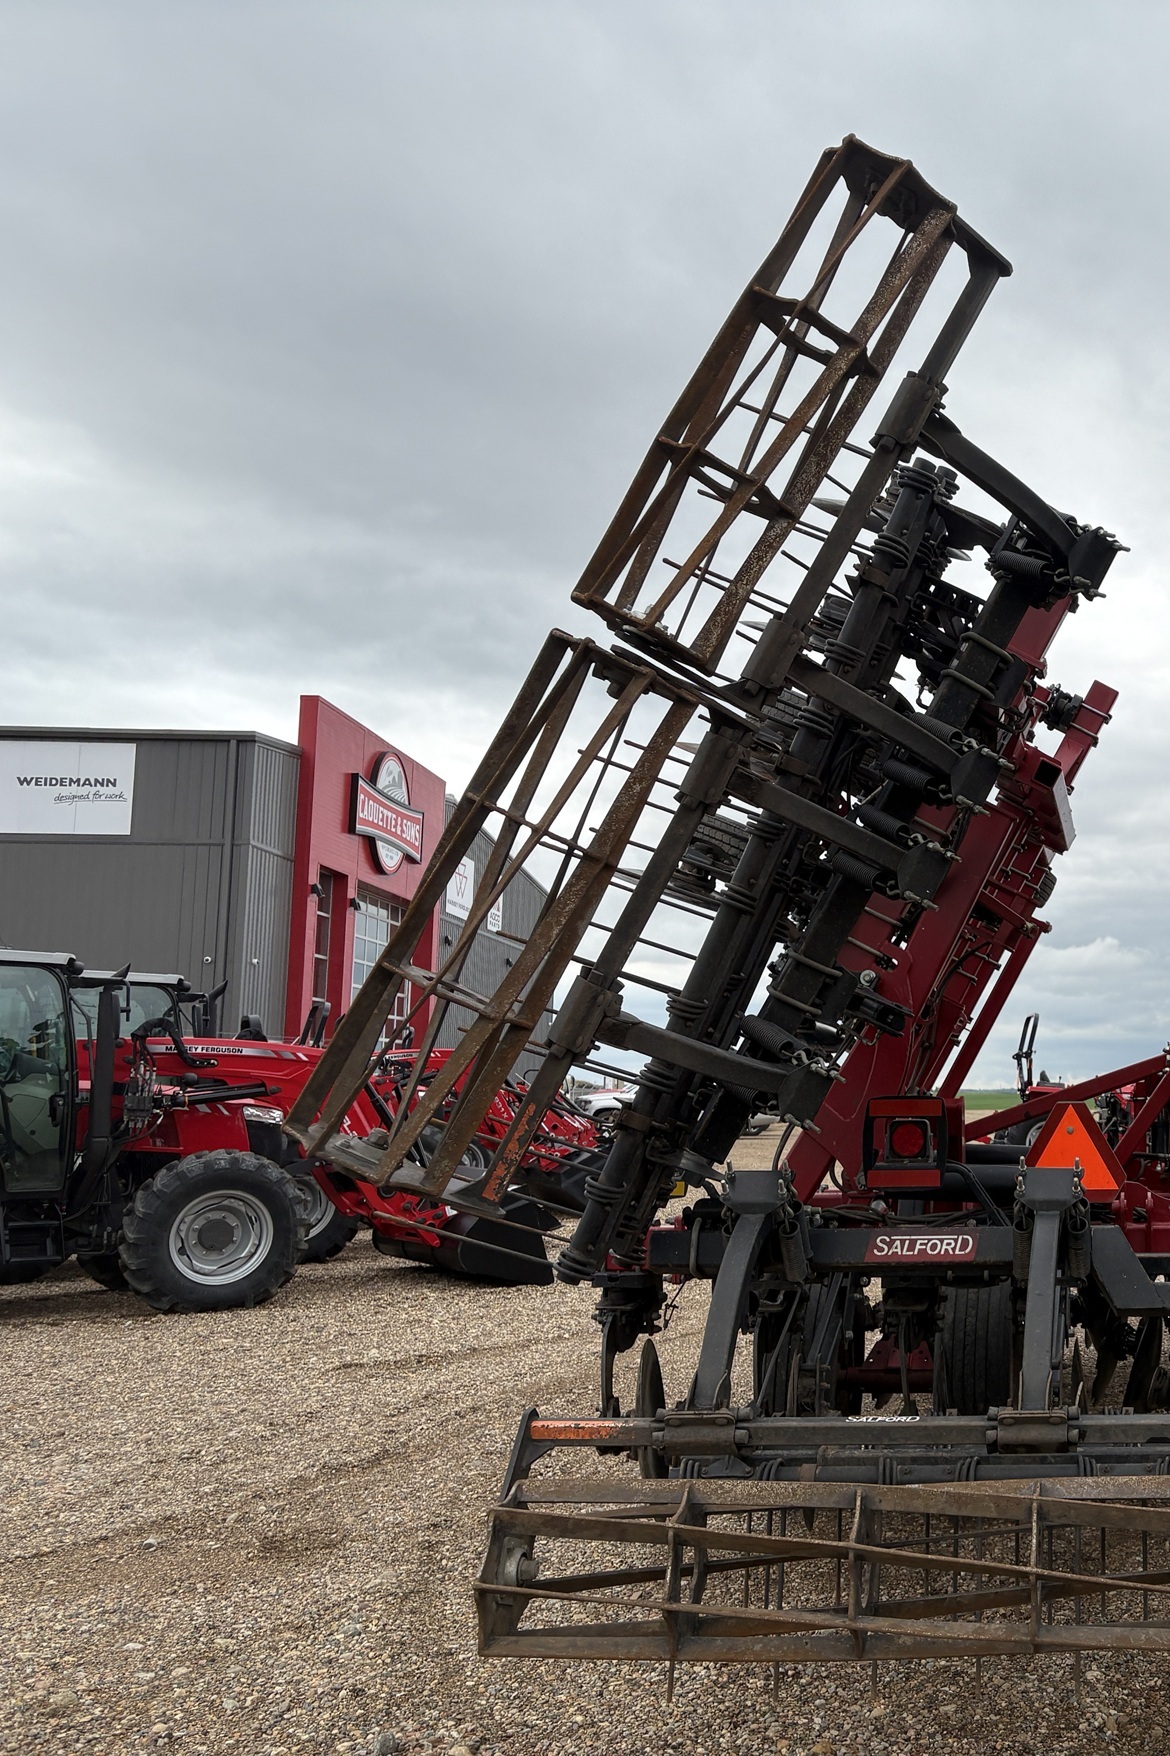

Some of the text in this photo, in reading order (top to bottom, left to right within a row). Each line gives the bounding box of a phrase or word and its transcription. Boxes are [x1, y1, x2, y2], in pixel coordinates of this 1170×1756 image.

[16, 776, 117, 788] WEIDEMANN
[54, 790, 127, 805] designed for work
[397, 816, 402, 836] &
[402, 819, 420, 847] SONS
[165, 1045, 243, 1054] MAEY FERGUSON
[873, 1235, 973, 1256] SALFORD
